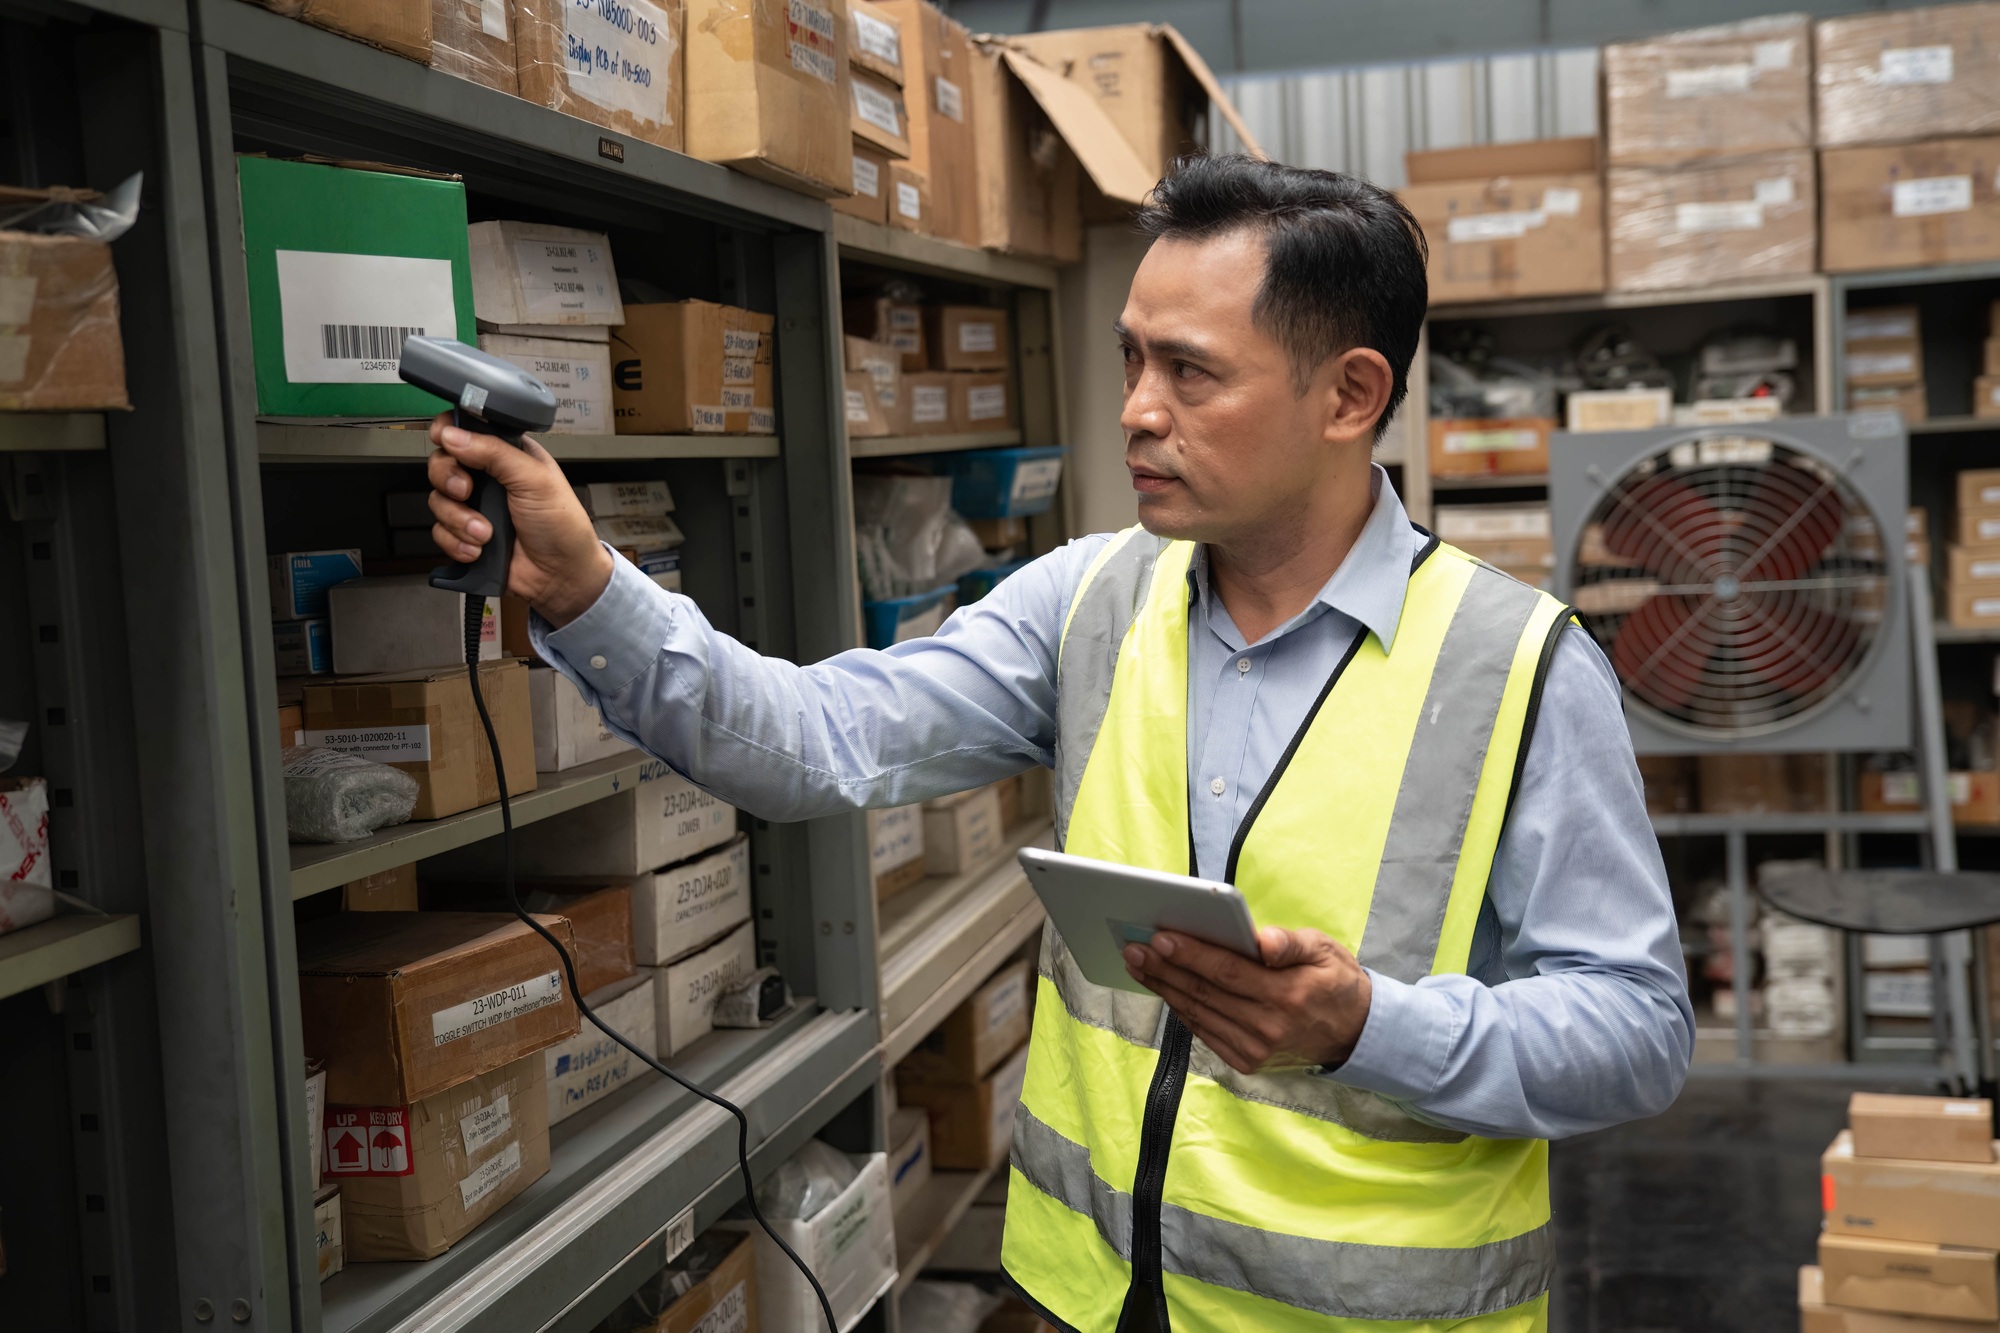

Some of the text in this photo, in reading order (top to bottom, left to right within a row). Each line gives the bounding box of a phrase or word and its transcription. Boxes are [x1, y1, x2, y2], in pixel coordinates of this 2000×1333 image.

[569, 34, 592, 75] Display
[596, 46, 609, 70] PCB
[602, 141, 623, 158] DAIWA
[360, 361, 397, 371] 12345678
[615, 407, 641, 417] nc.
[325, 732, 406, 744] 53-5010-1020020-11
[332, 745, 348, 753] Motor
[349, 745, 362, 753] with
[363, 743, 391, 752] connector
[401, 742, 422, 750] PT-102
[678, 817, 701, 836] LOWER
[472, 984, 527, 1015] 23-WDP-011
[435, 1028, 461, 1047] TOGGLE
[462, 1017, 487, 1036] SWITCH
[488, 1012, 502, 1025] WDP
[503, 1009, 512, 1020] for
[336, 1113, 357, 1127] UP
[369, 1111, 403, 1126] KEEP DRY
